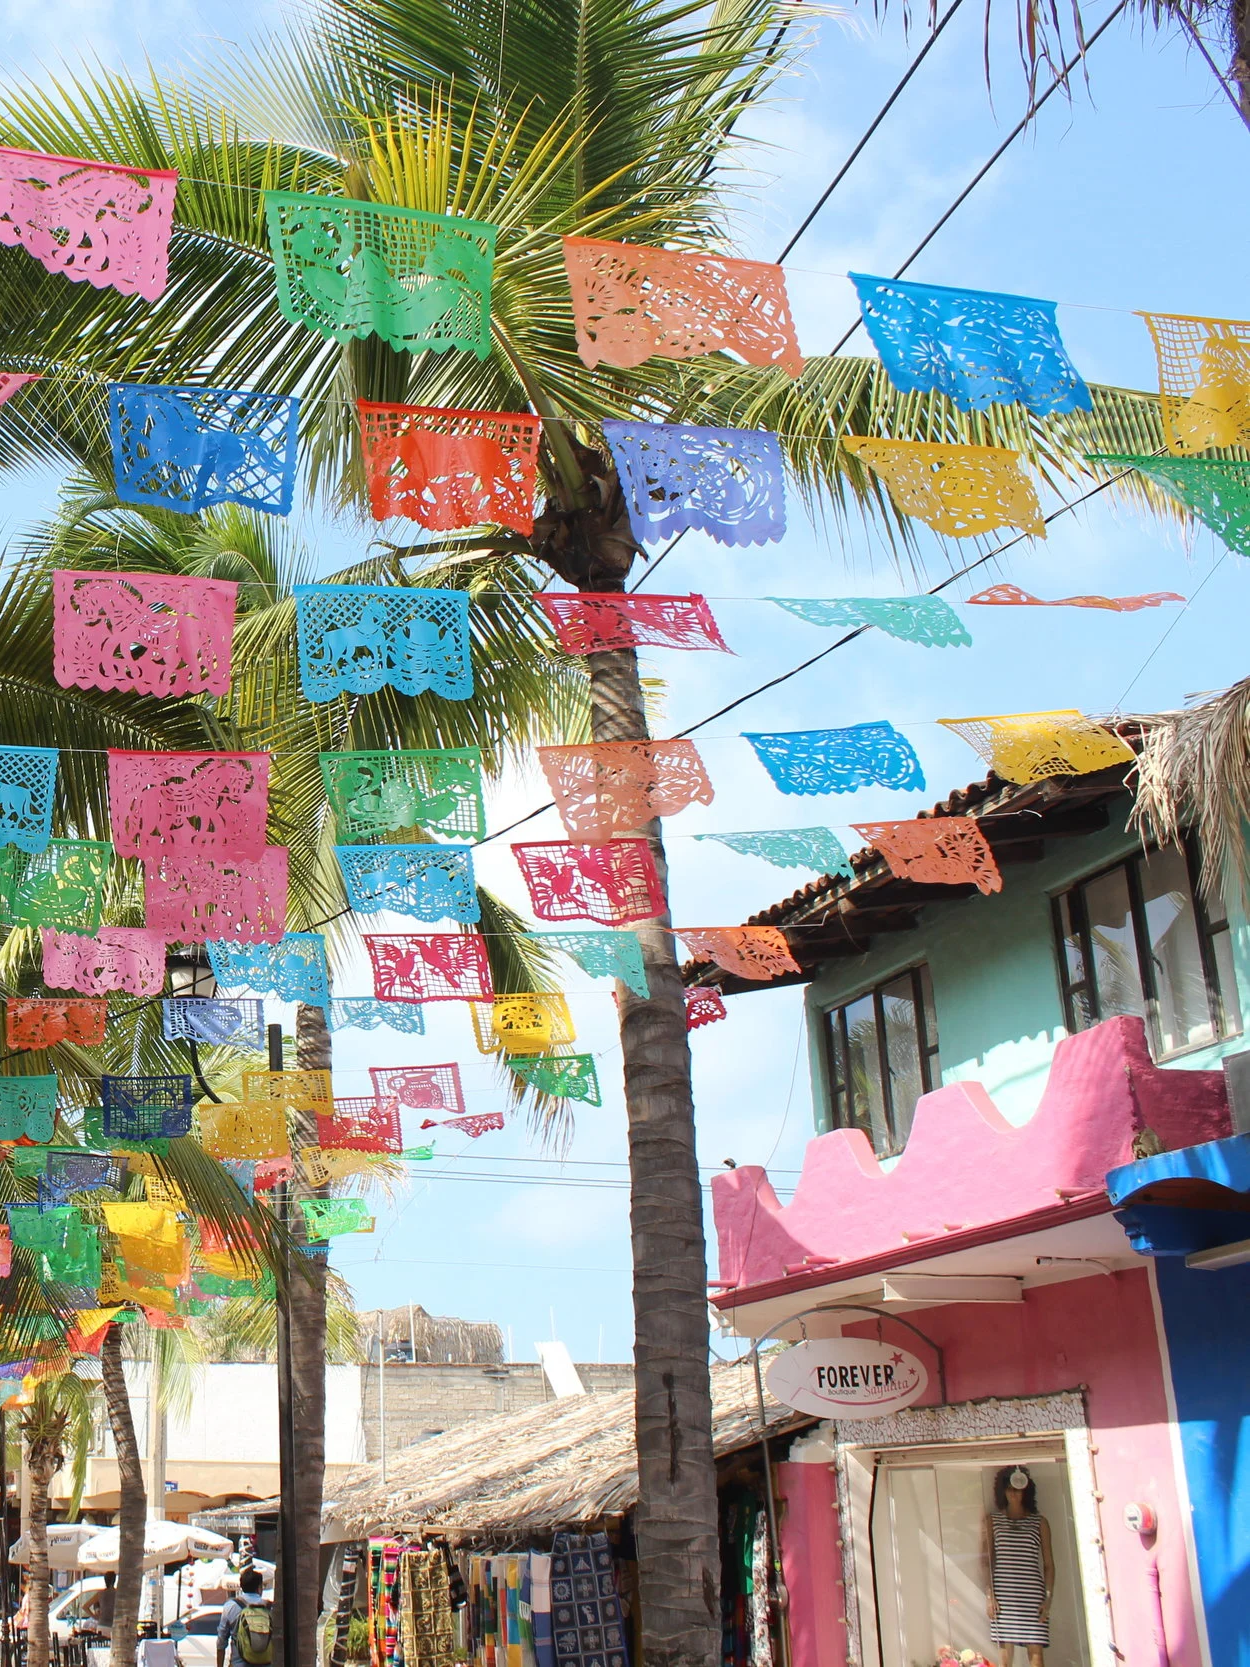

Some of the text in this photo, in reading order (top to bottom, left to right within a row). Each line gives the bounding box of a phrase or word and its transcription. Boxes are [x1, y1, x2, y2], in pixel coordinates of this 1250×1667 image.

[816, 1364, 894, 1389] FOREVER
[828, 1378, 910, 1399] Boutique Sayulita
